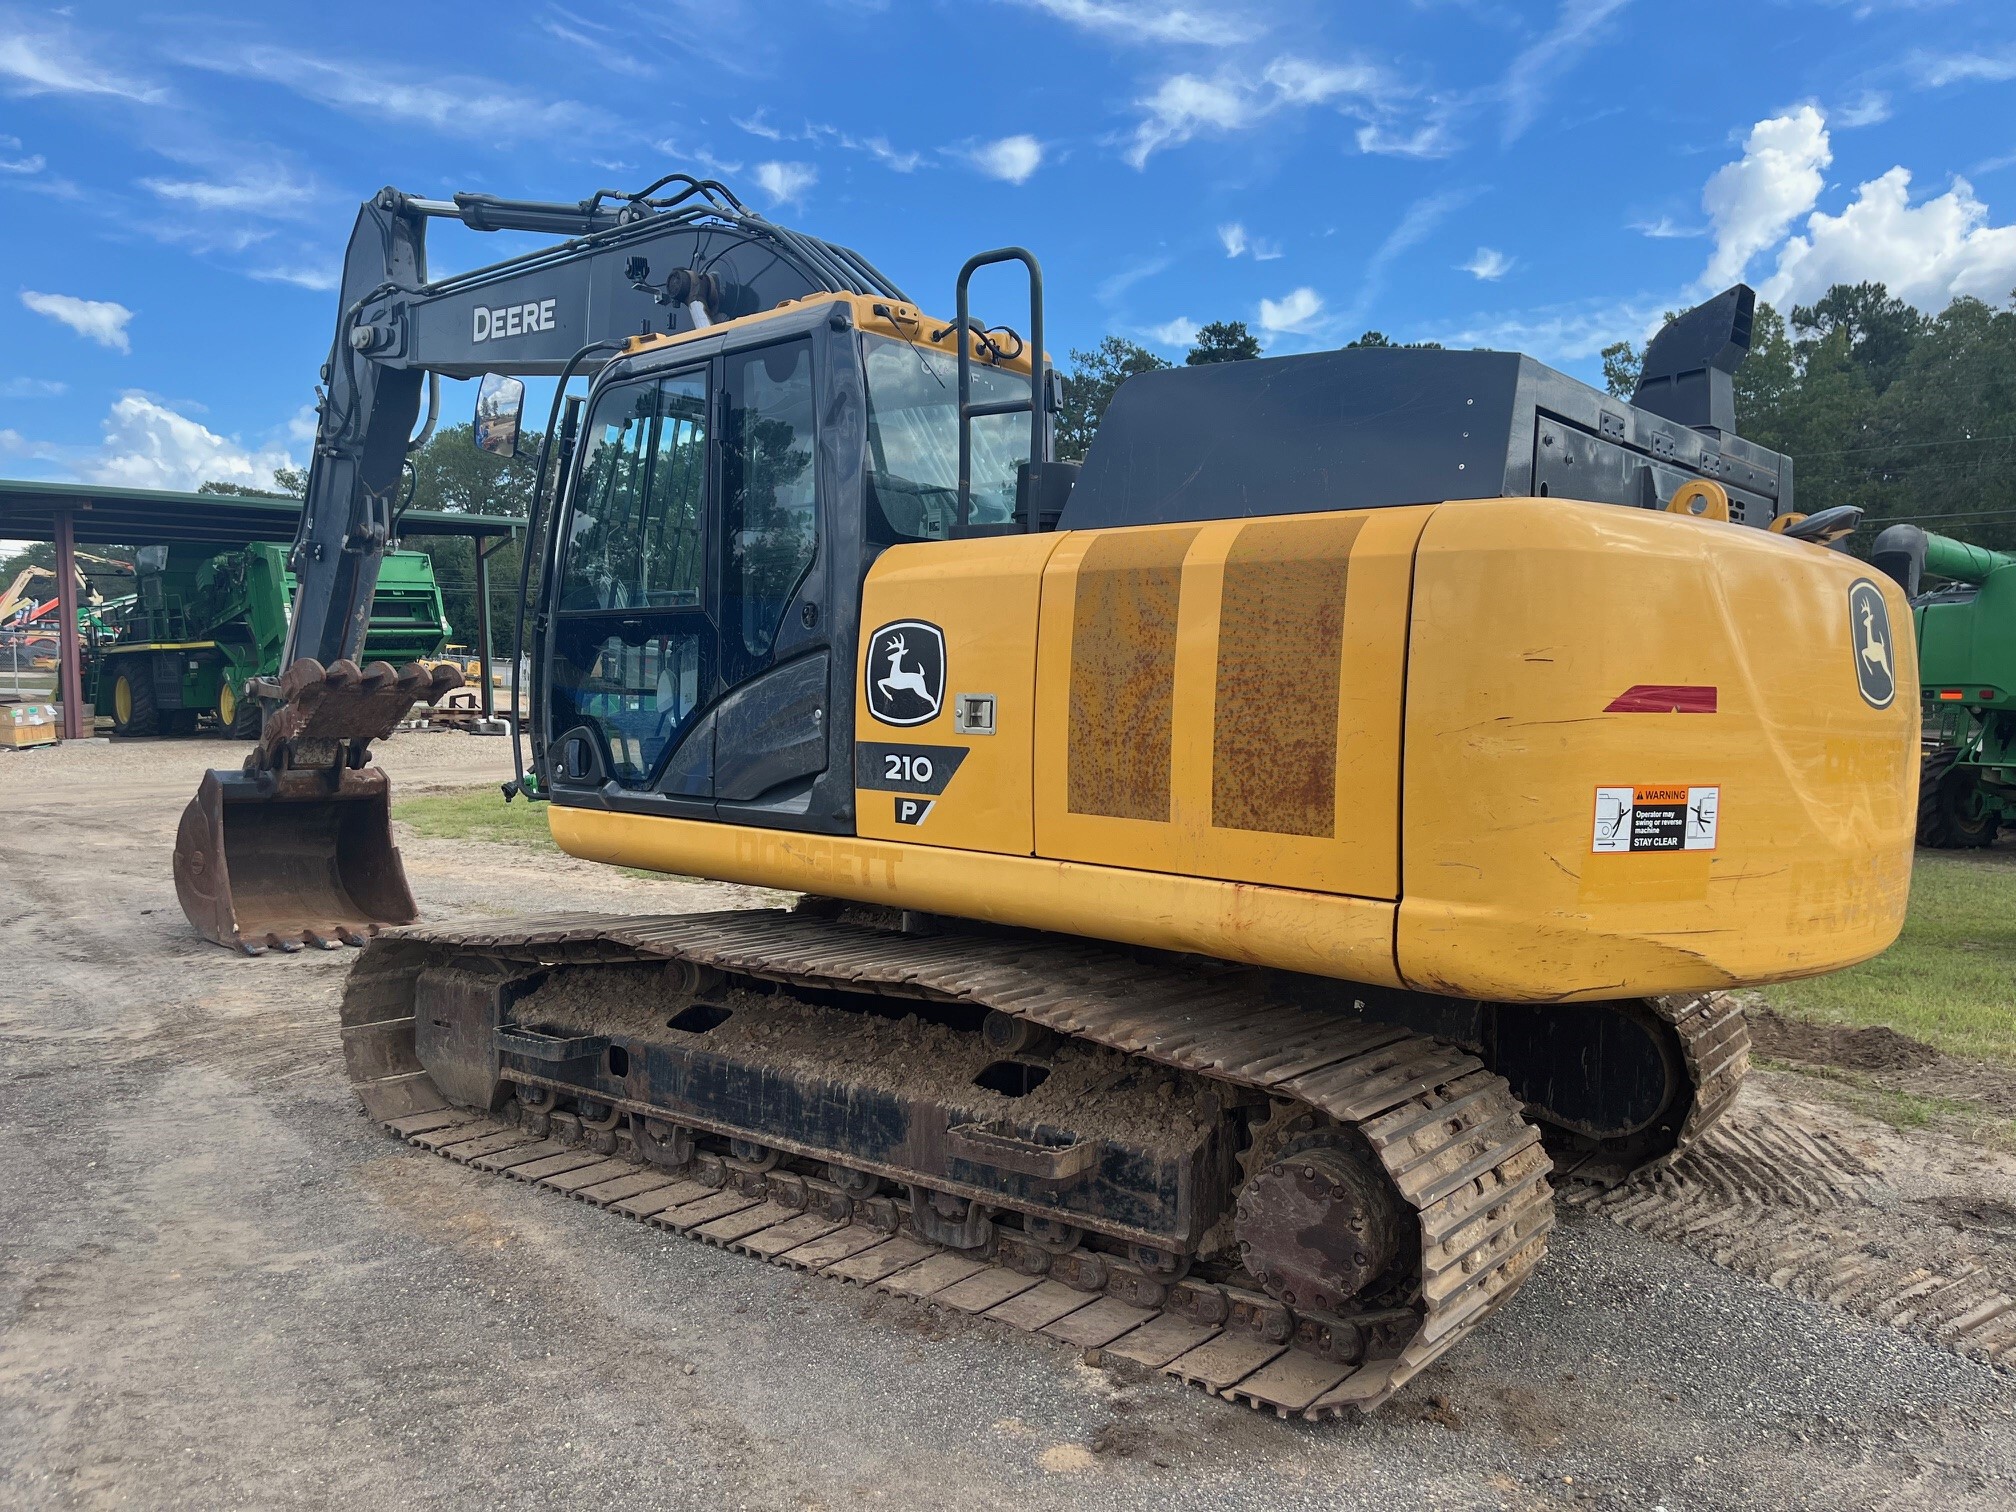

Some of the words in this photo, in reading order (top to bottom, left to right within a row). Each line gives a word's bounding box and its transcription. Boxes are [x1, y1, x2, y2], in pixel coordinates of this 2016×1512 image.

[473, 298, 556, 342] DEERE
[885, 754, 933, 783] 210
[1645, 790, 1686, 800] WARNING
[1636, 810, 1662, 819] Operator
[1662, 811, 1676, 819] may
[1635, 819, 1653, 827] swing
[1633, 837, 1653, 847] STAY
[1653, 837, 1678, 846] CLEAR
